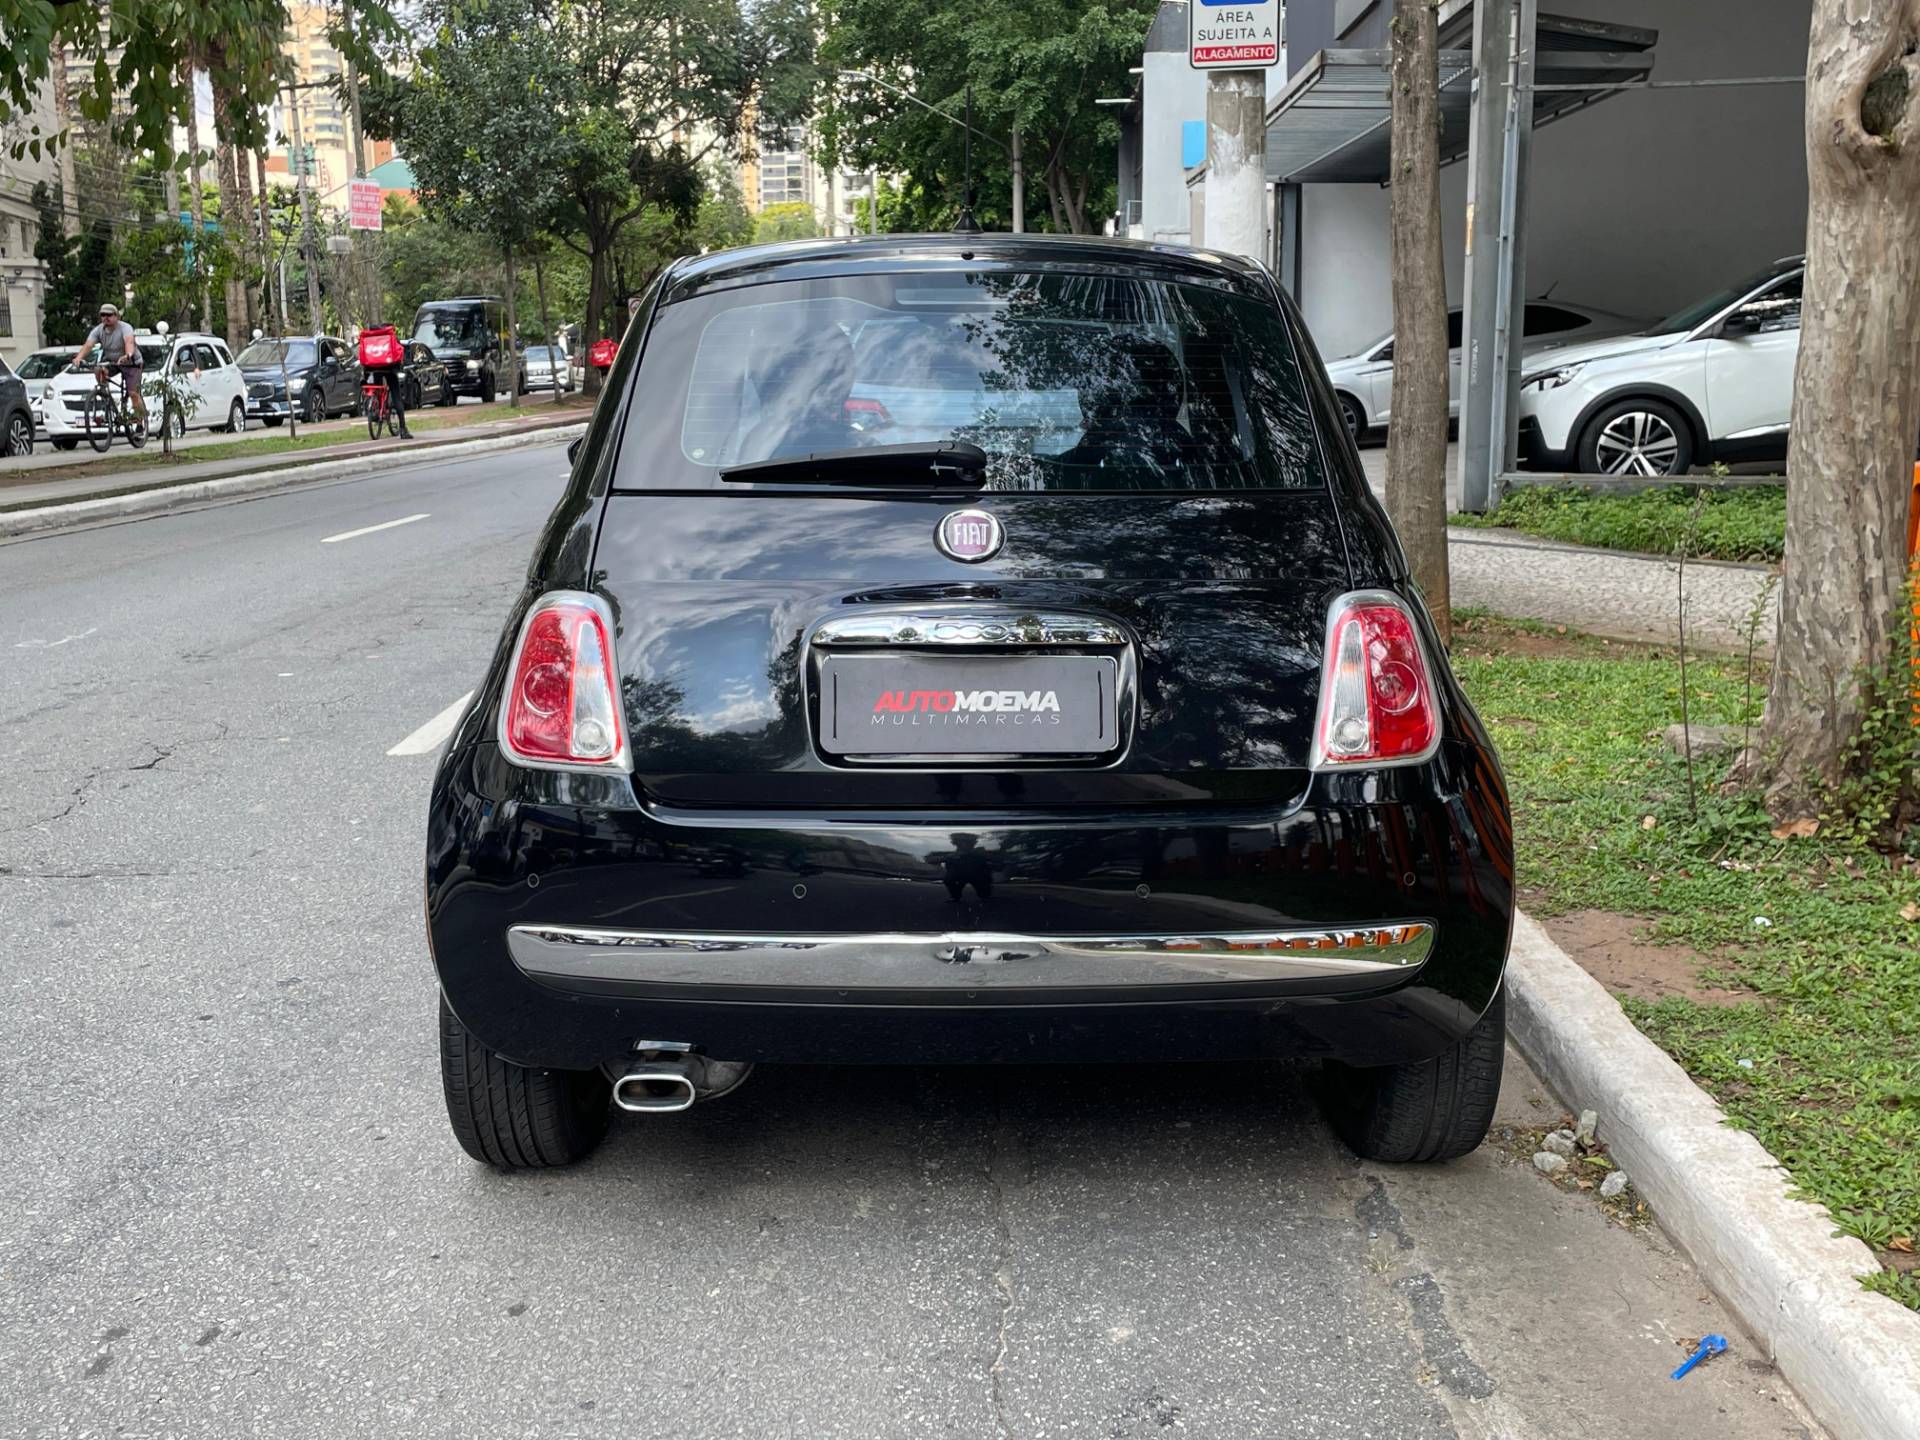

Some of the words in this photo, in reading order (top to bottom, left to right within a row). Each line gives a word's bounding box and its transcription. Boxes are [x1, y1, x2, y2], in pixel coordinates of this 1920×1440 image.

[1216, 9, 1254, 23] ÁREA
[1198, 28, 1256, 41] SUJEITA
[1263, 27, 1272, 38] A
[1195, 46, 1275, 60] ALAGAMENTO
[953, 522, 989, 545] FIAT
[871, 714, 1061, 725] MULTIMARCAS
